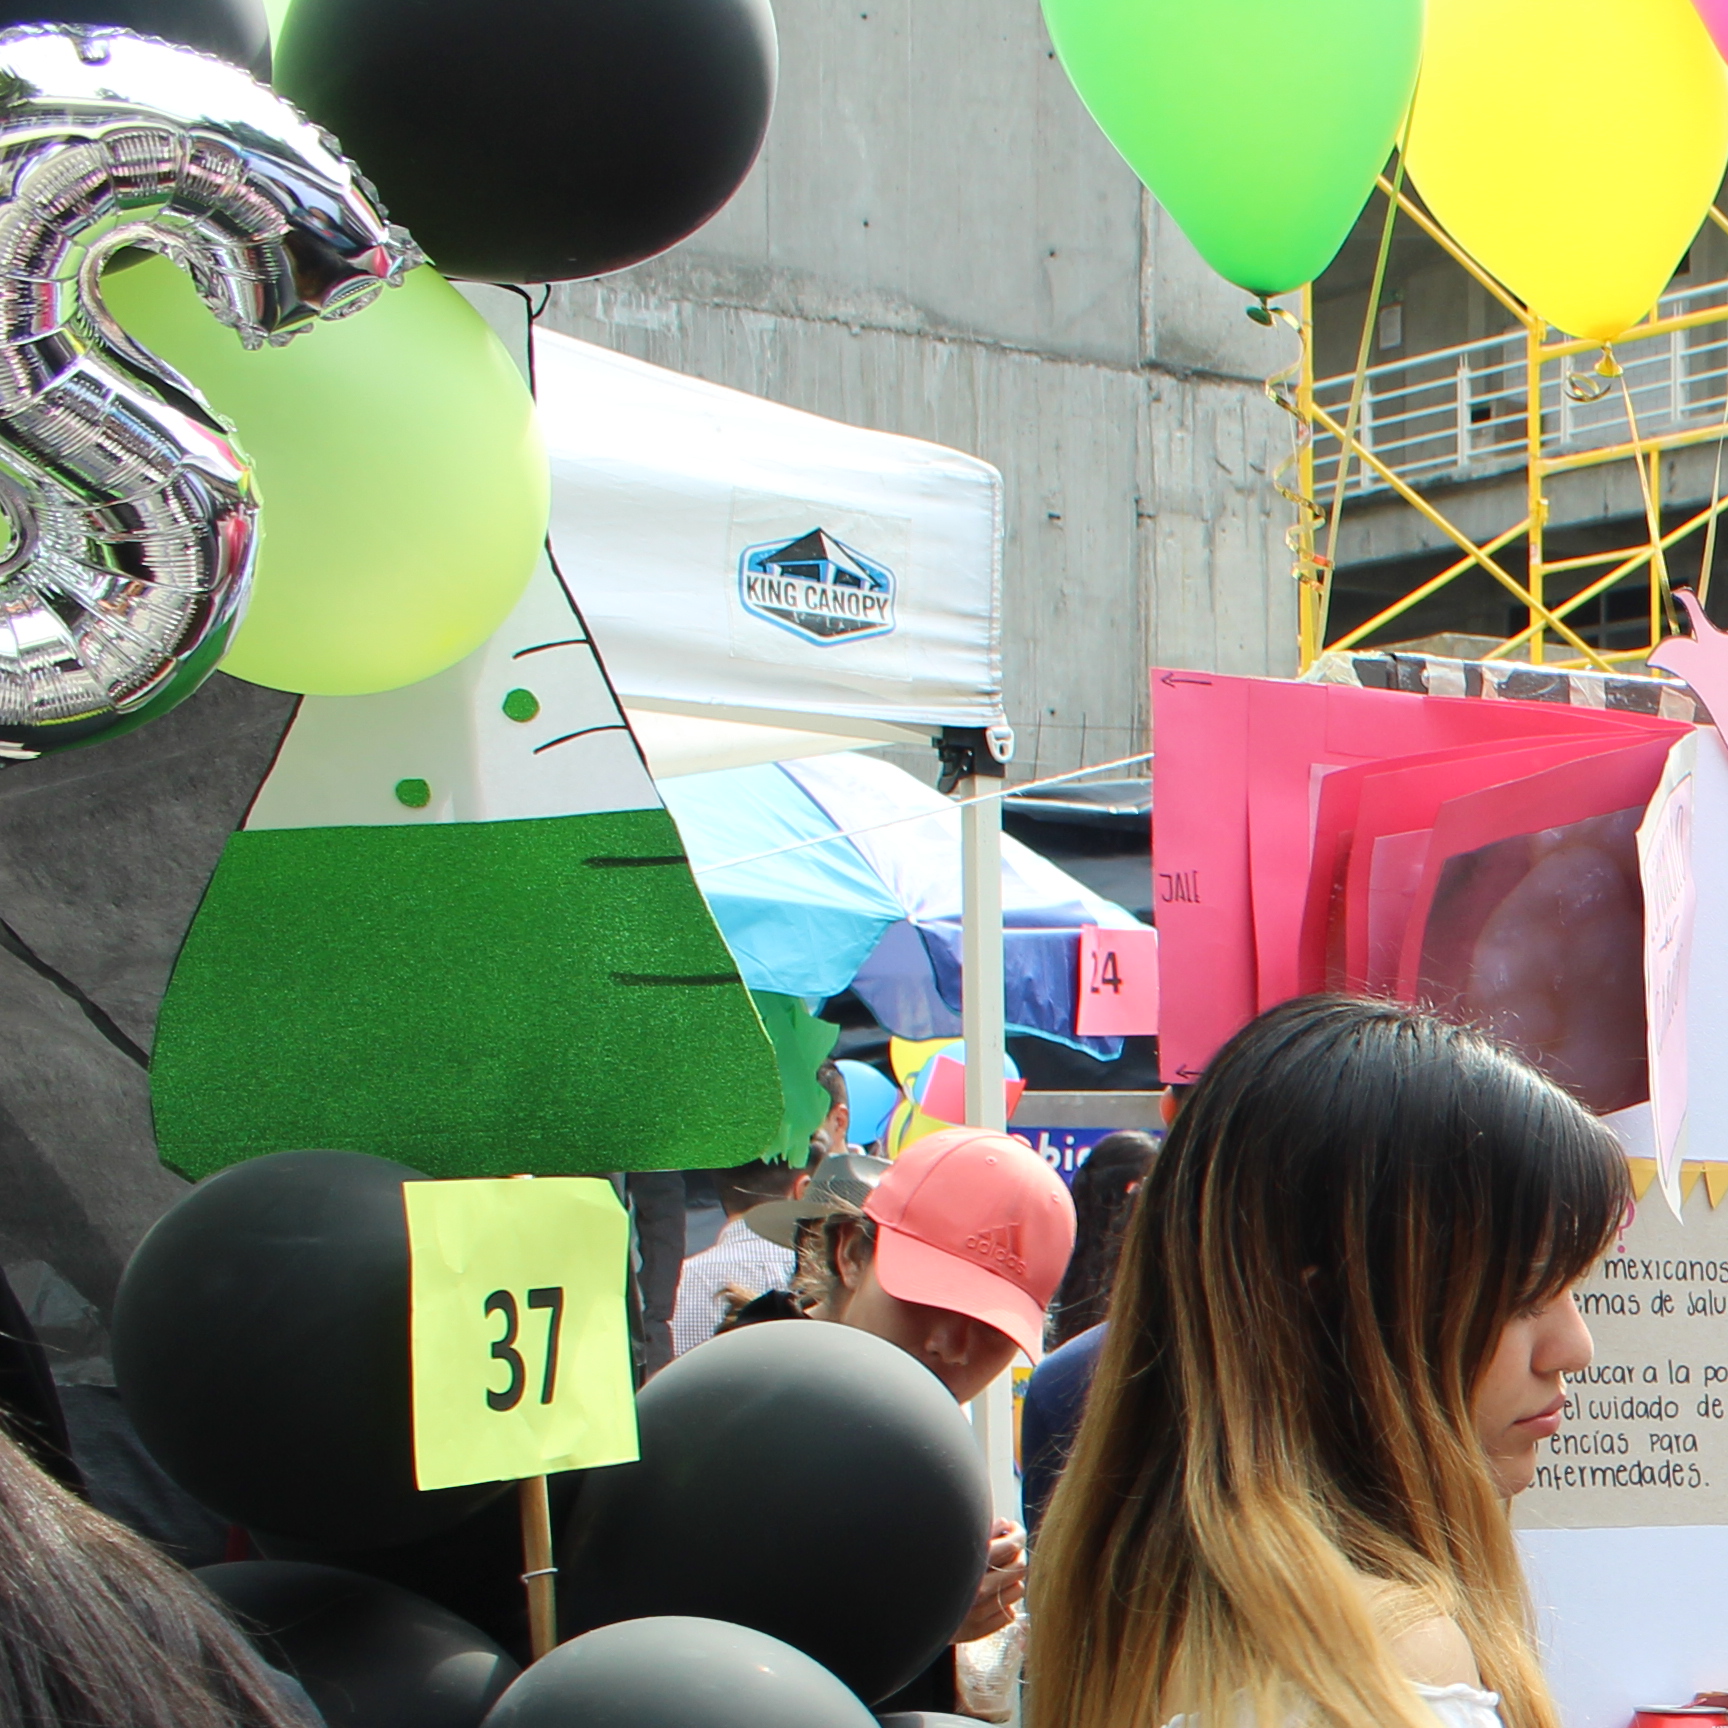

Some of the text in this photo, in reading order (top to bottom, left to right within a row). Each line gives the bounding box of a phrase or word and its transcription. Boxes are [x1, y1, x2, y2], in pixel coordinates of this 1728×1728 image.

[747, 576, 889, 620] KING CANOPY
[1159, 870, 1200, 903] JALE
[1090, 951, 1122, 994] 24
[966, 1234, 1027, 1275] adidas
[1651, 1289, 1675, 1317] de
[484, 1287, 564, 1412] 37
[1643, 1366, 1657, 1383] a
[1668, 1359, 1690, 1385] la
[1589, 1394, 1724, 1421] cuidado de
[1550, 1430, 1698, 1455] encías para
[1527, 1459, 1710, 1491] nfermedades.
